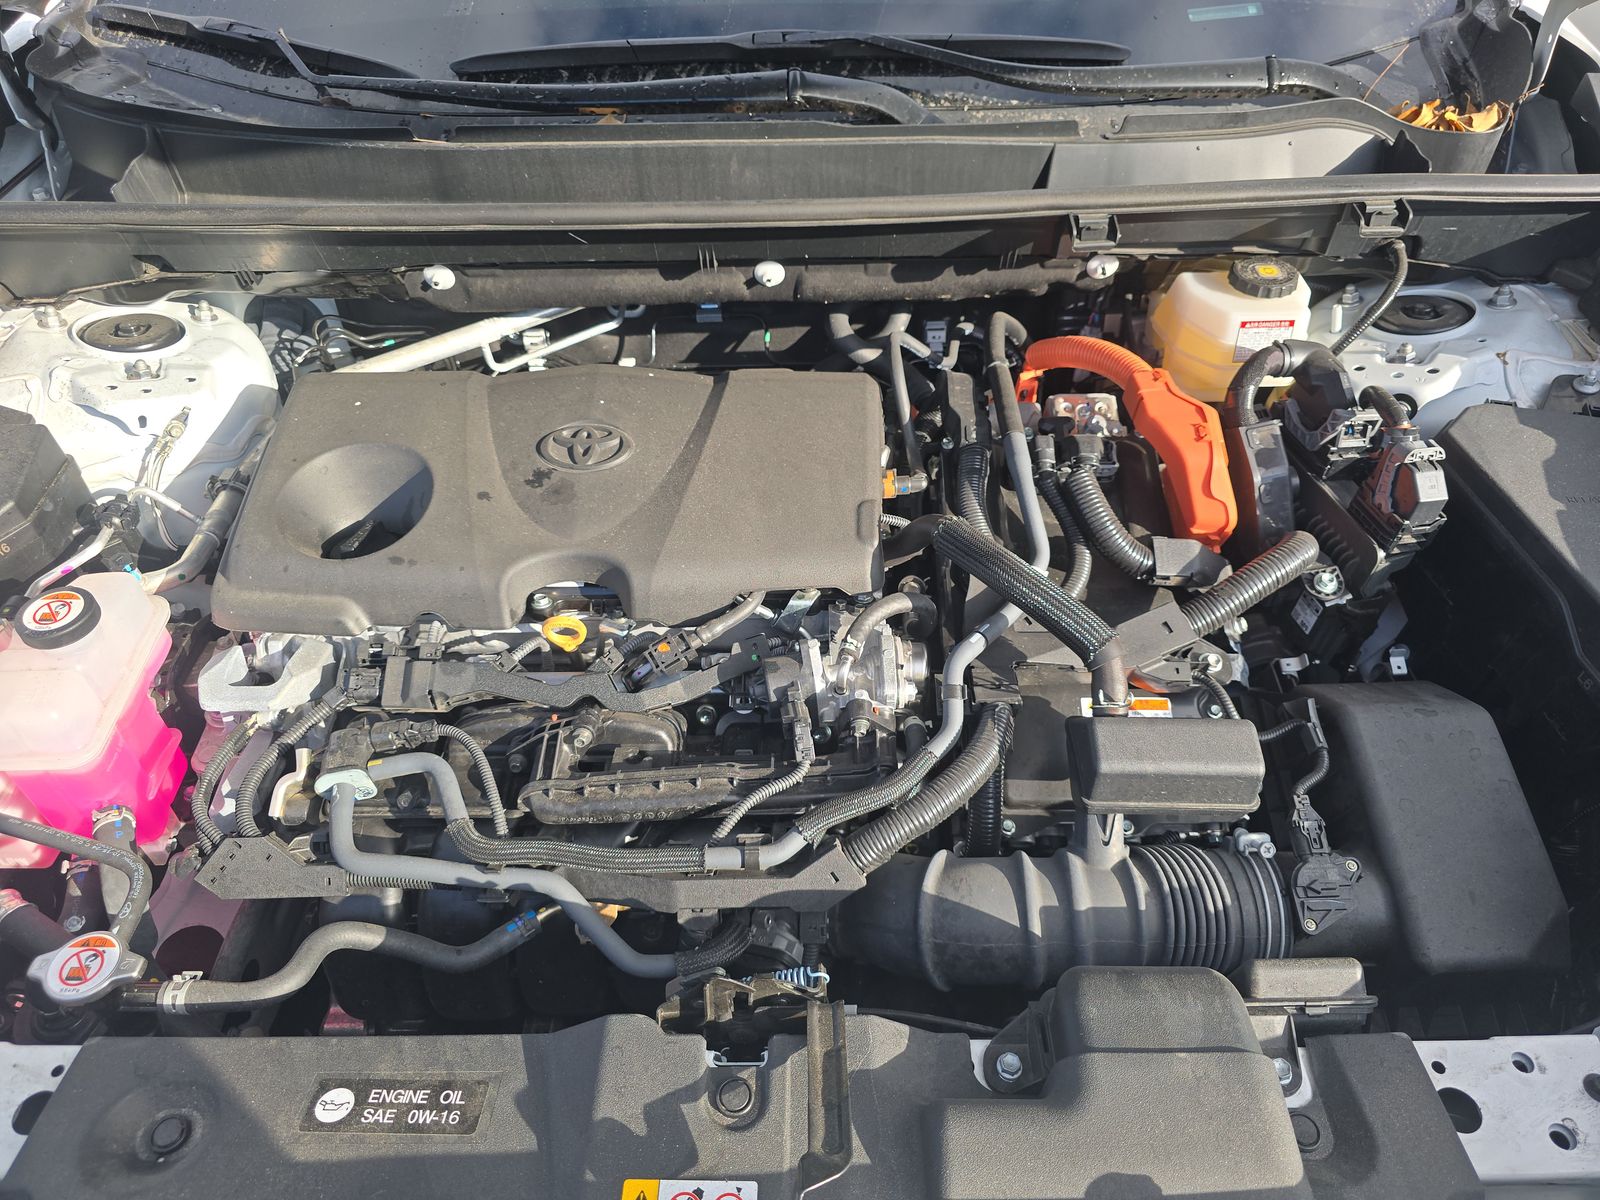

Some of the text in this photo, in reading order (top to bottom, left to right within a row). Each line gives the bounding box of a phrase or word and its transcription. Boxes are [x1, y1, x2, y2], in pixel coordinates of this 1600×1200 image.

[367, 1089, 466, 1105] ENGINE OIL
[360, 1108, 460, 1125] SAE 0W-16
